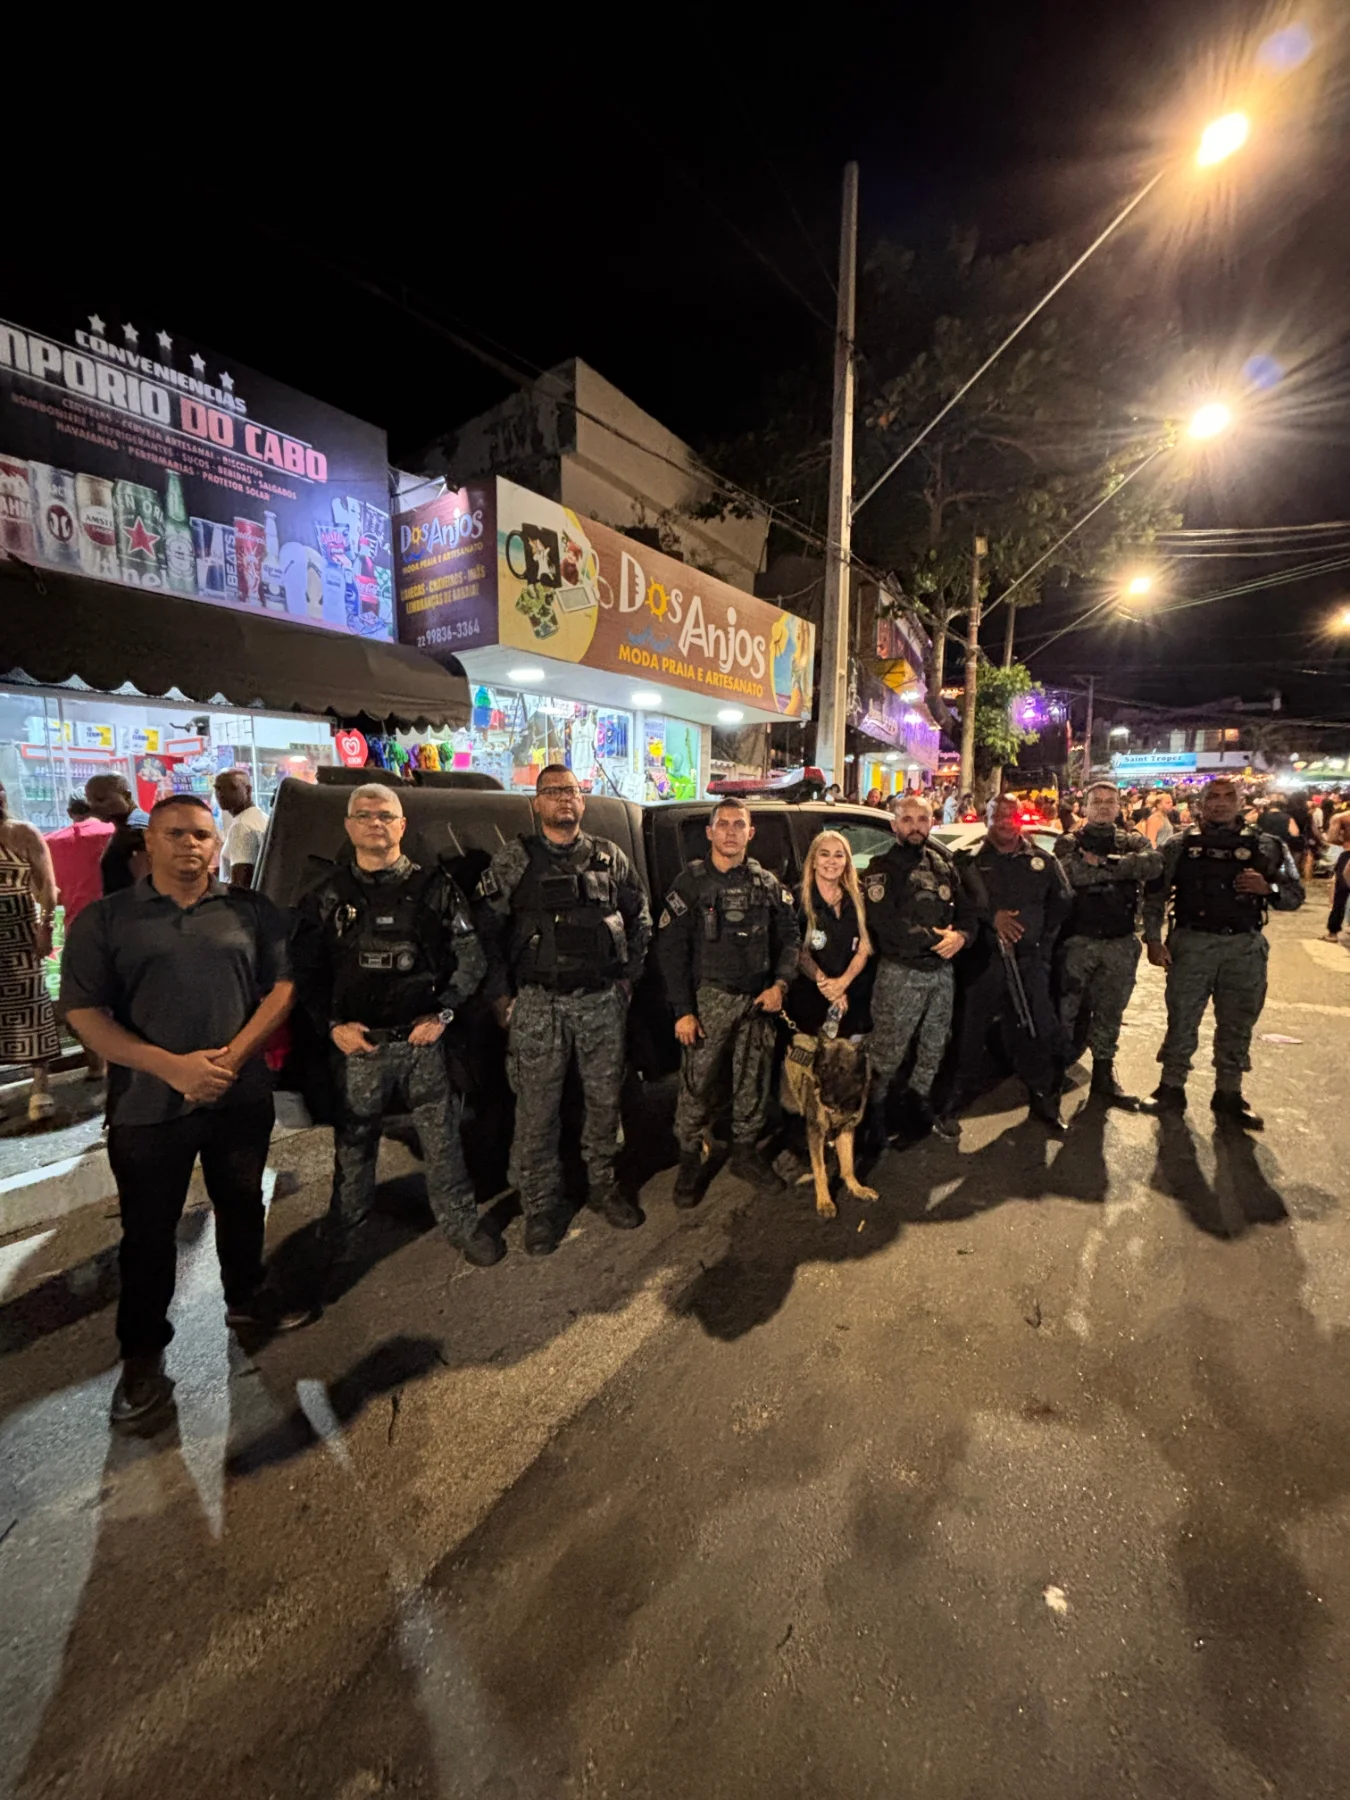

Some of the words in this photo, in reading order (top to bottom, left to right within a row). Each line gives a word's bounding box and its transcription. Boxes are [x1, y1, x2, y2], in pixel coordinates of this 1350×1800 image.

[75, 329, 248, 414] CONVENIENCIAS
[56, 421, 119, 451] HAVAIANAS
[127, 446, 195, 476] PERFUMARIAS
[202, 471, 244, 493] PROTETOR
[245, 486, 271, 501] SOLAR
[180, 397, 234, 449] DO
[245, 424, 327, 483] CABO
[182, 452, 210, 470] SUCOS
[217, 465, 252, 485] BEBIDAS
[257, 480, 297, 500] SALGADOS
[222, 456, 264, 478] BISCOITOS
[225, 532, 238, 585] BEATS
[442, 541, 484, 563] ARTESANATO
[426, 618, 480, 645] 99836-3364
[618, 644, 659, 670] MODA
[662, 656, 695, 681] PRAIA
[697, 667, 703, 682] E
[705, 669, 763, 698] ARTESANATO
